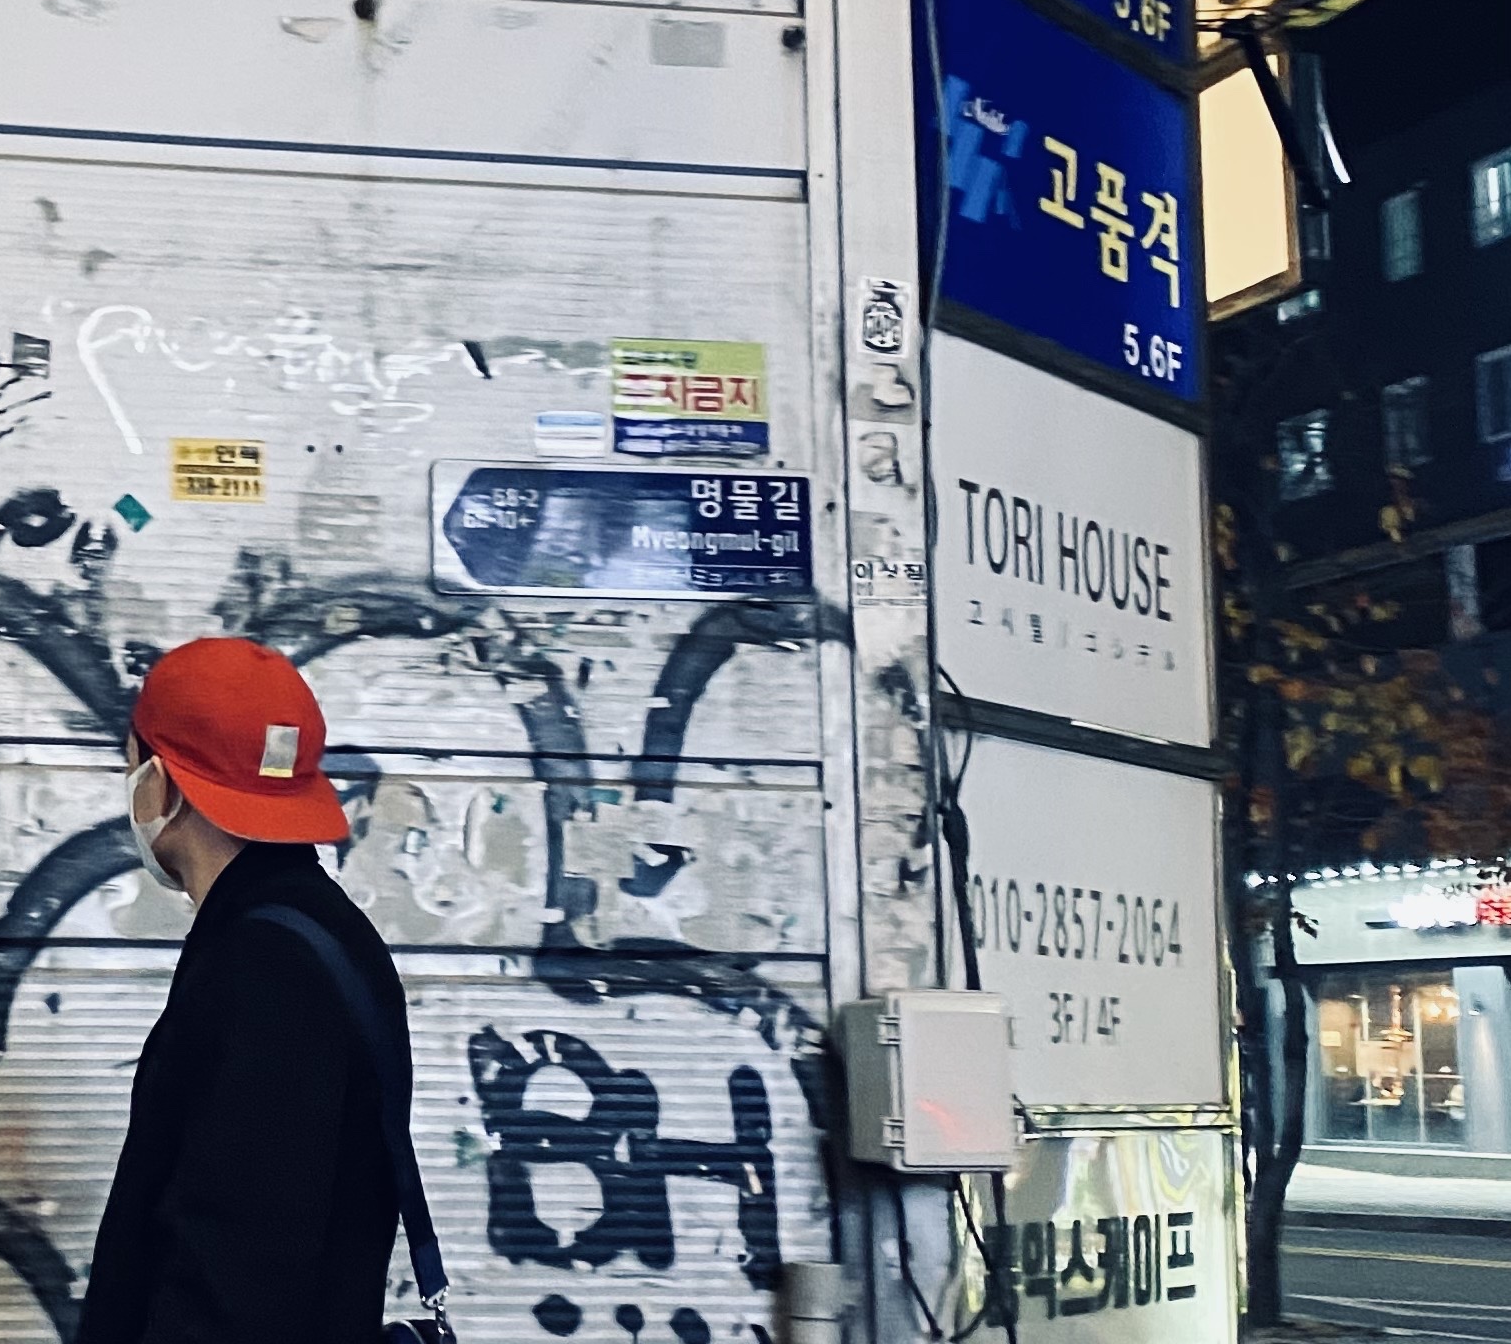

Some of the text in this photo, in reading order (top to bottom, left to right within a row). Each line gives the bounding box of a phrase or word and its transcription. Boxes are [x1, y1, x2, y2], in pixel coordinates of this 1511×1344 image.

[1039, 135, 1181, 310] 고품격
[1123, 323, 1183, 383] 5.6F
[691, 479, 801, 522] 명물길
[631, 525, 800, 556] Myeongmul-gil
[959, 479, 1172, 621] TORI HOUSE
